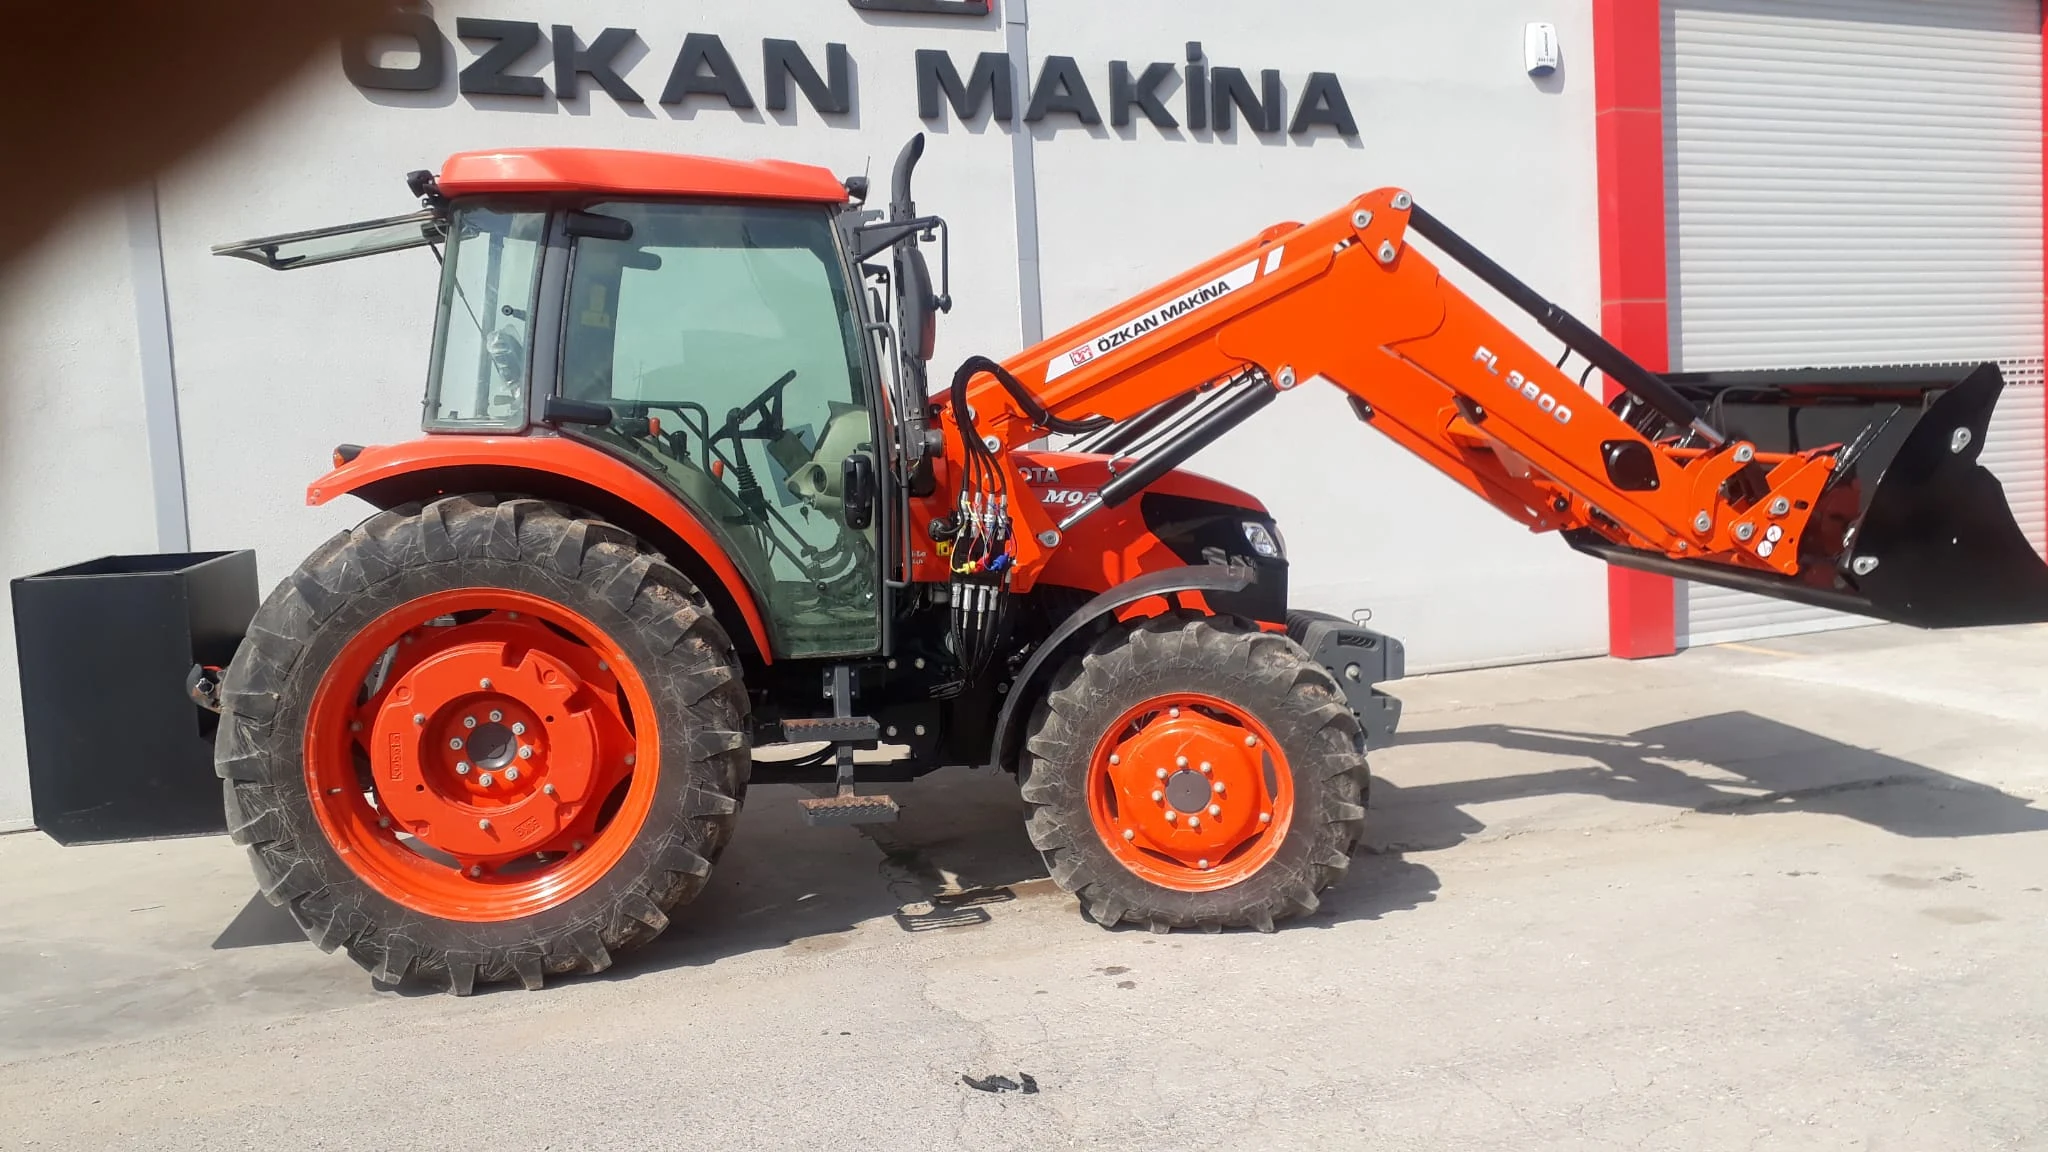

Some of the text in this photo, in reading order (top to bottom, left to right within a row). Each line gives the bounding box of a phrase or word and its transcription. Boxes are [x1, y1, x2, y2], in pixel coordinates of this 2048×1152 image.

[915, 41, 1359, 135] MAKİNA
[1097, 280, 1231, 352] ÖZKAN MAKİNA
[1473, 346, 1572, 424] FL 3800
